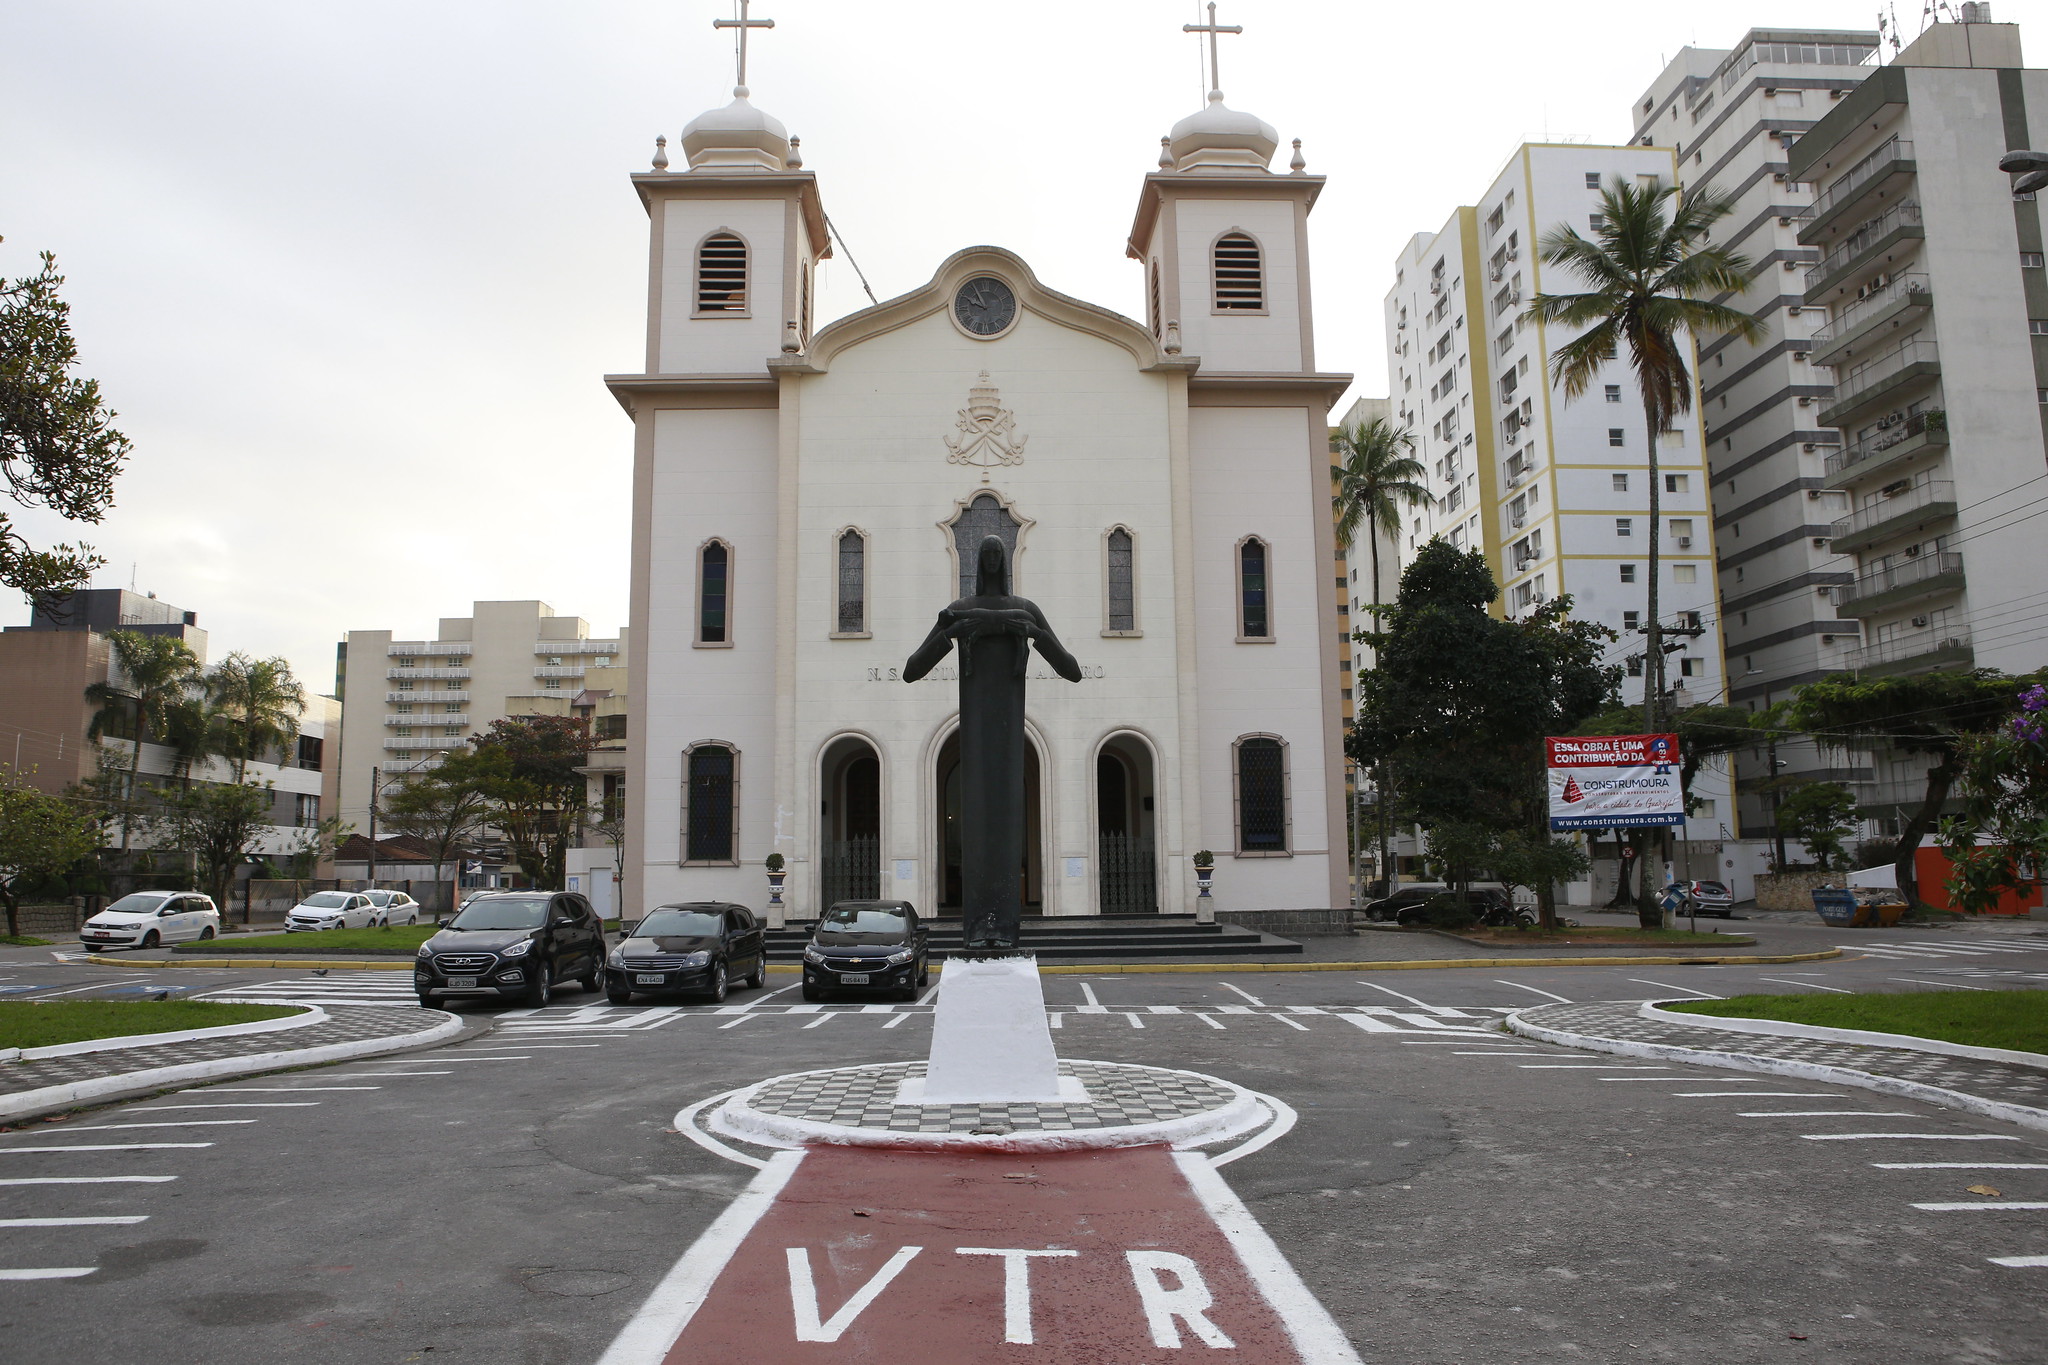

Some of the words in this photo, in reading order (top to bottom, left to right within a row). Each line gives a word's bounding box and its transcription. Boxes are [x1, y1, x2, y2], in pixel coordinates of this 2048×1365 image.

[1554, 743, 1580, 752] ESSA
[1582, 742, 1611, 751] OBRA
[1613, 739, 1619, 750] É
[1621, 741, 1644, 750] UMA
[1555, 750, 1629, 764] CONTRIBUIÇÃO
[1631, 752, 1645, 761] DA
[1584, 778, 1669, 790] CONSTRUMOURA
[1558, 815, 1677, 826] www.construmoura.com.br
[786, 1246, 1236, 1349] VTR
